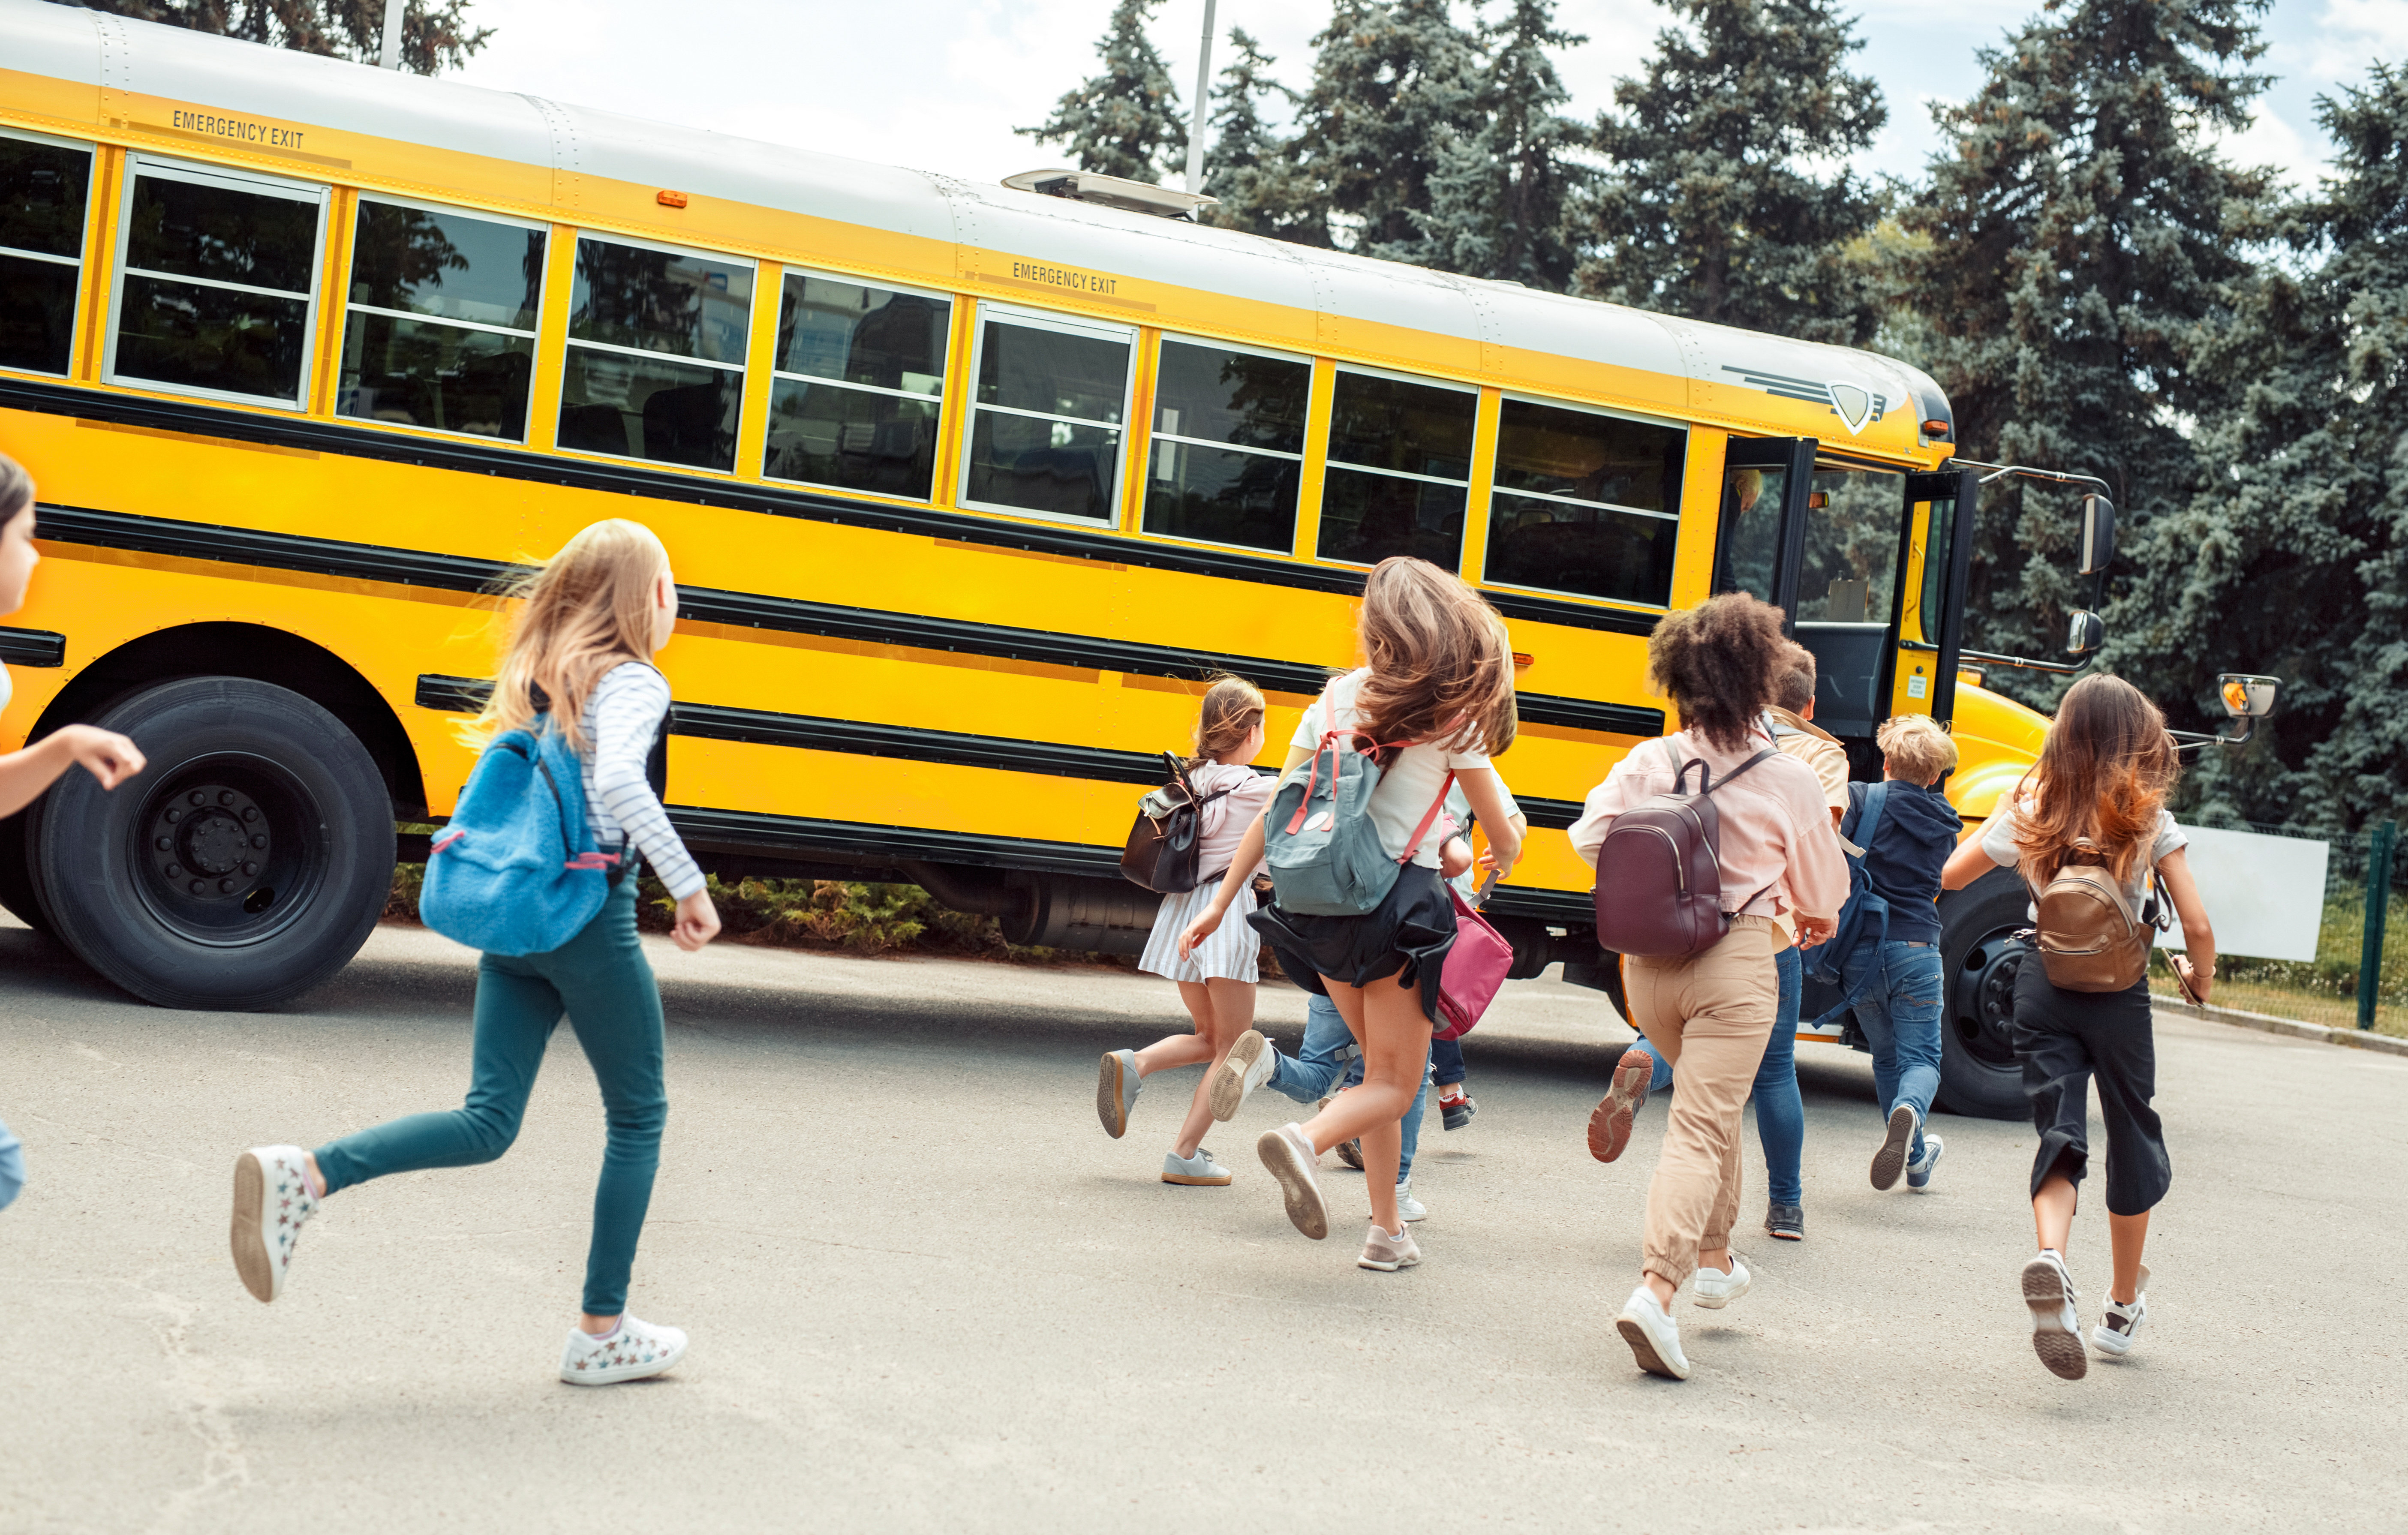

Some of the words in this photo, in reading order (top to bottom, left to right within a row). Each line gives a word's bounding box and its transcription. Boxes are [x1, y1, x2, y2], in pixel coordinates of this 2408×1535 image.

[174, 110, 267, 142] EMERGENCY
[271, 128, 303, 149] EXIT
[1013, 262, 1087, 289] EMERGENCY
[1091, 276, 1116, 294] EXIT
